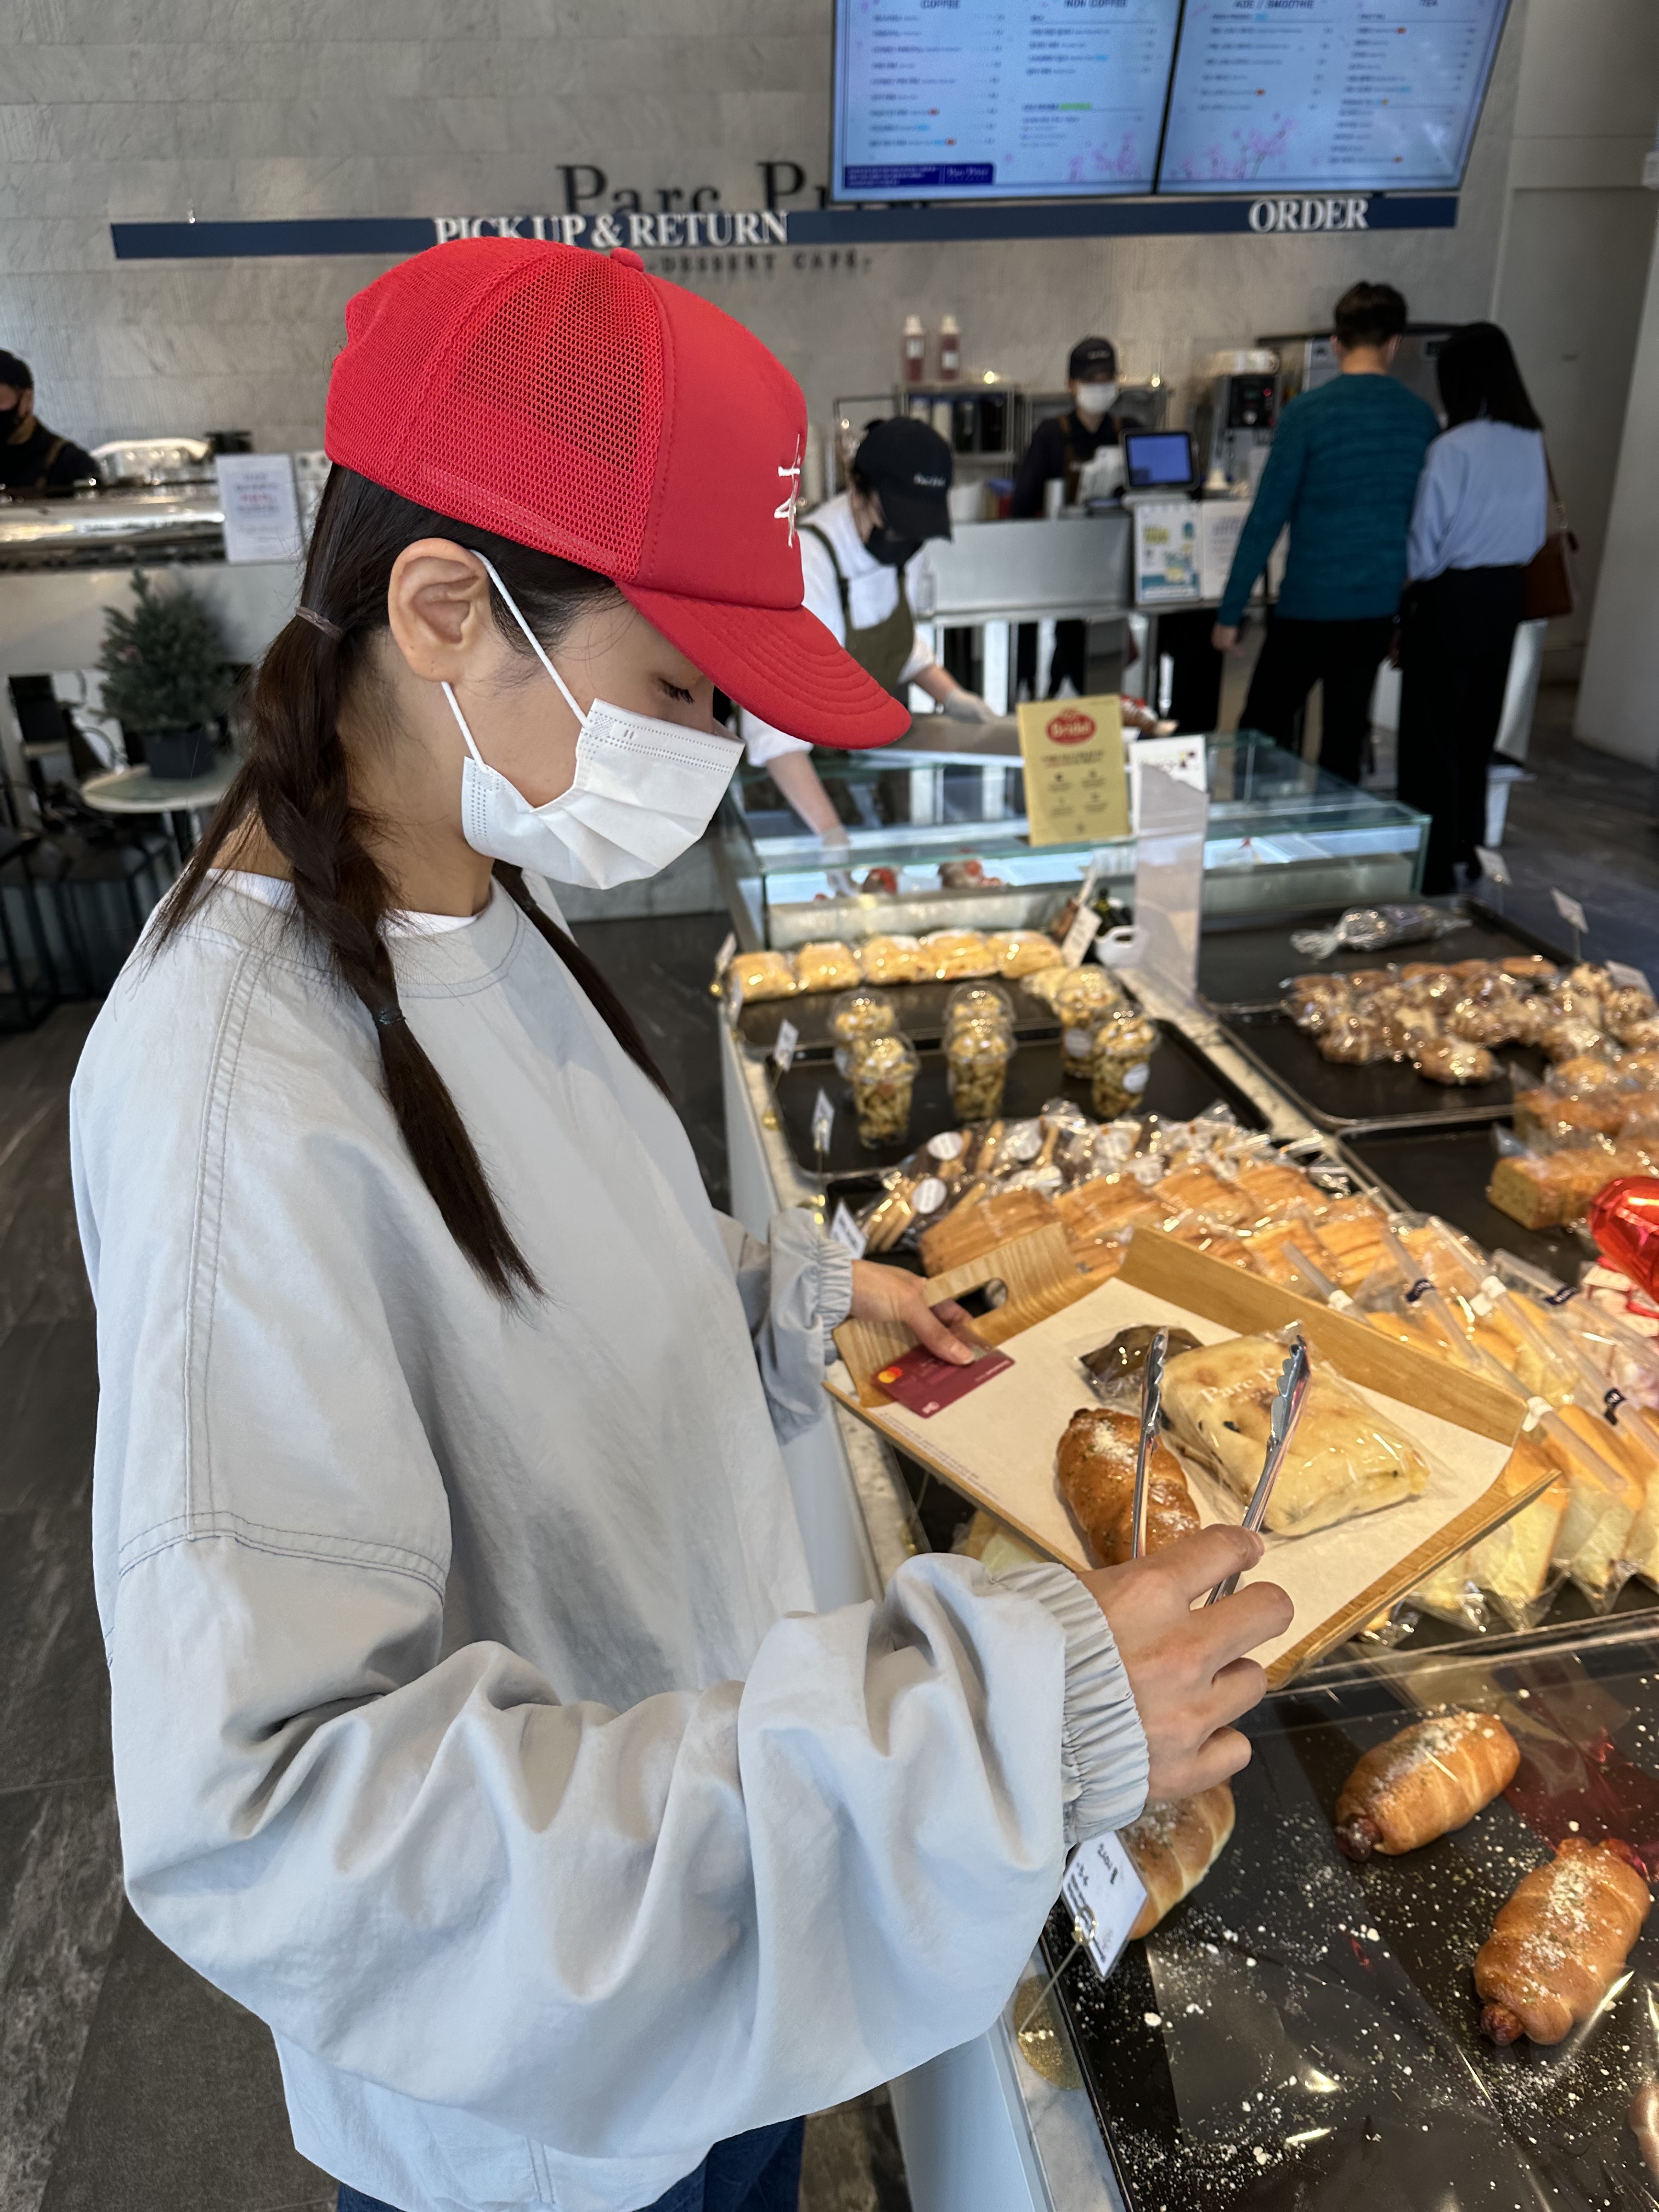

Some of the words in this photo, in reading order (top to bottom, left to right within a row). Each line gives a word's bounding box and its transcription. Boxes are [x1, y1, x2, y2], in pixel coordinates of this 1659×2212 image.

[555, 163, 720, 213] Parc
[436, 216, 523, 244] PICK
[533, 215, 586, 246] UP
[591, 213, 623, 247] &
[629, 211, 787, 246] RETURN
[1248, 198, 1369, 233] ORDER
